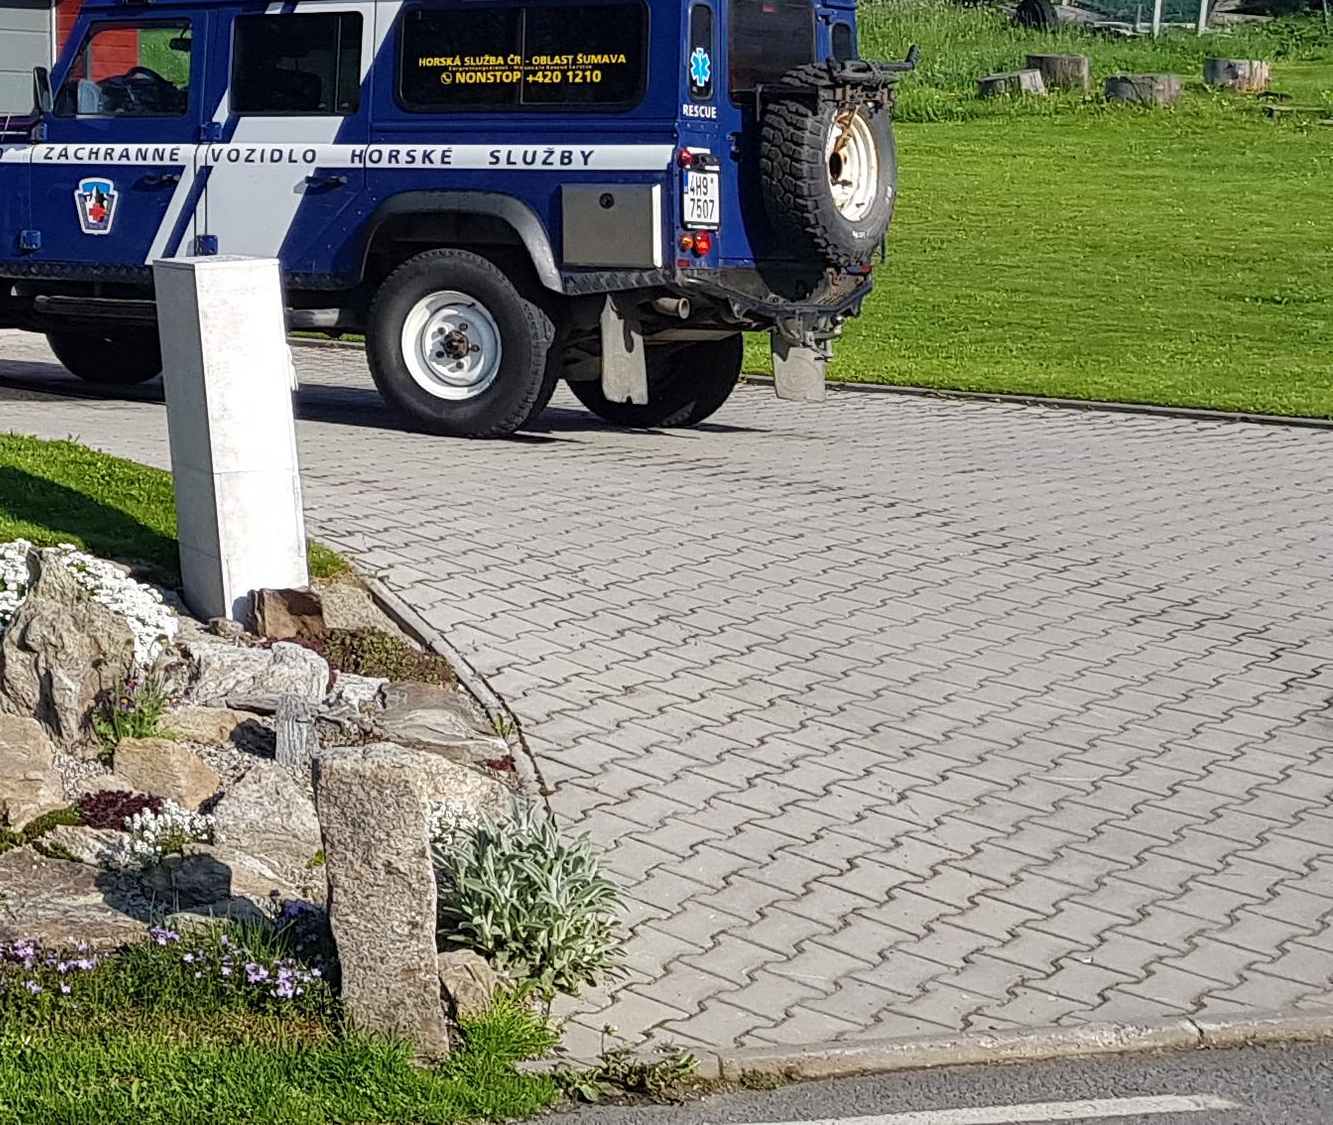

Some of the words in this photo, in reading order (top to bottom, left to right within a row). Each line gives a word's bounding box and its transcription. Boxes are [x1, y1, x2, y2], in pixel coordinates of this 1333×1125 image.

[418, 55, 461, 67] HORSKÁ
[464, 54, 504, 66] SLUŽBA
[507, 53, 521, 65] ČR
[532, 55, 574, 65] OBLAST
[576, 52, 626, 64] ŠUMAVA
[455, 71, 521, 83] NONSTOP
[526, 70, 562, 83] +420
[566, 70, 602, 83] 1210
[682, 104, 717, 119] RESCUE
[210, 148, 317, 164] VOZIDLO
[350, 147, 453, 165] HORSKÉ
[488, 147, 595, 166] SLUŽBY
[690, 175, 708, 196] 4H9
[690, 198, 715, 219] 7507
